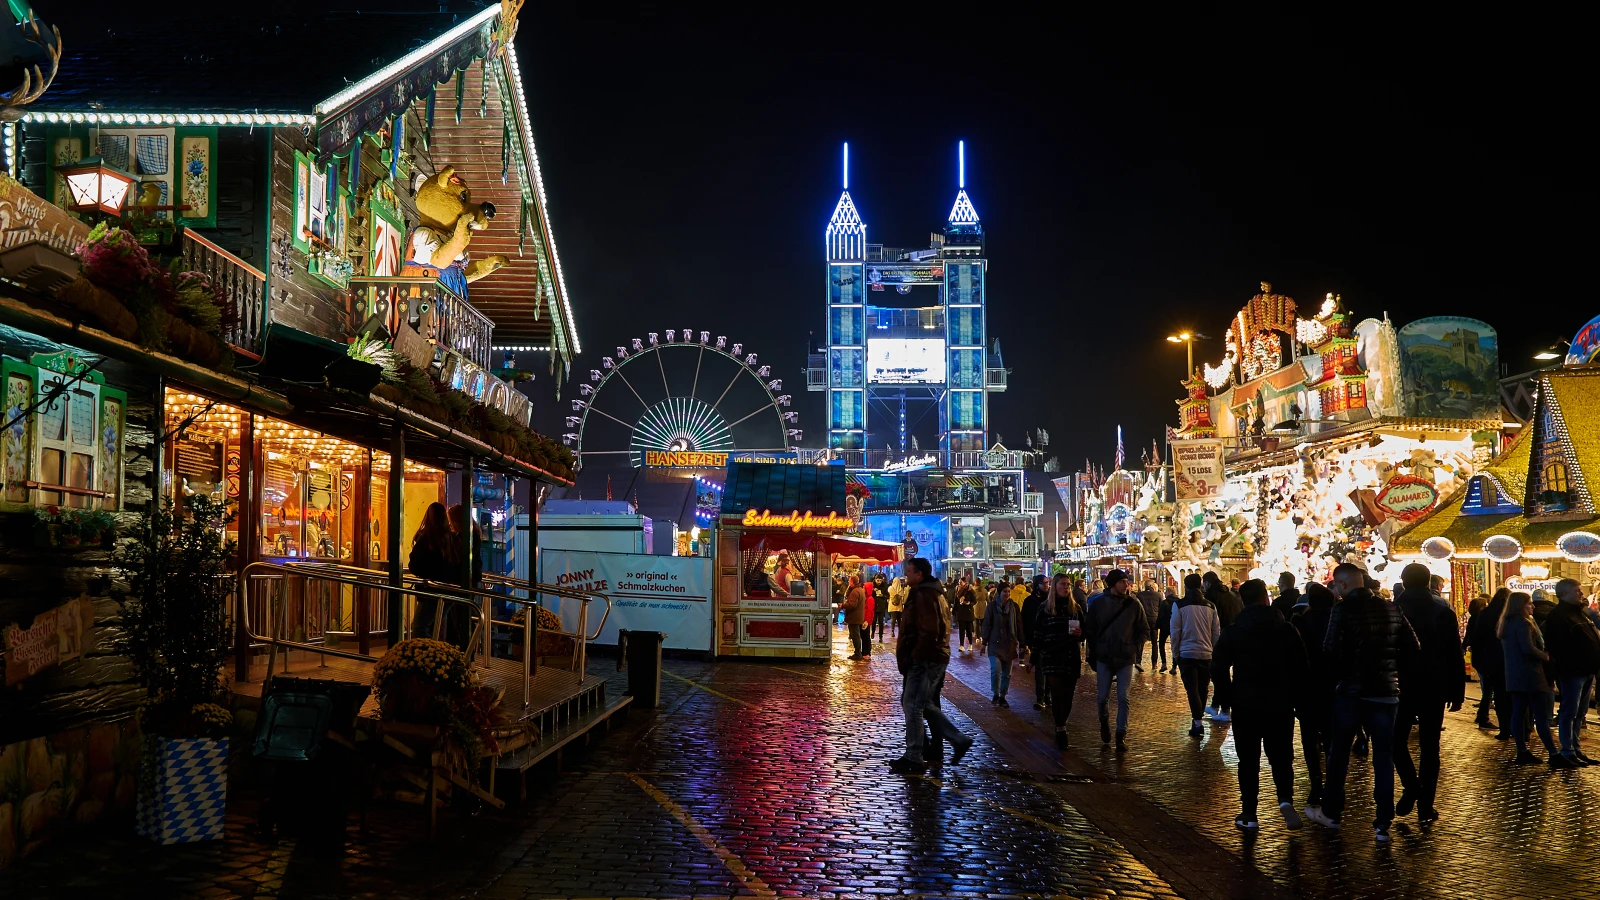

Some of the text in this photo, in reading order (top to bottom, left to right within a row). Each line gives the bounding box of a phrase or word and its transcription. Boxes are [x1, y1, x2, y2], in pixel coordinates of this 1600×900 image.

[645, 451, 729, 467] HANSEZELT
[883, 453, 937, 471] Event Center
[1187, 466, 1196, 474] 15
[1388, 491, 1430, 504] CALAMARES
[742, 508, 853, 532] Schmalzkuchen
[555, 568, 595, 586] JONNY
[635, 571, 669, 581] original
[618, 581, 686, 593] Schmalzkuchen
[10, 611, 57, 647] Vorsicht!
[14, 640, 44, 661] Bissige
[29, 644, 57, 674] Ferkel!
